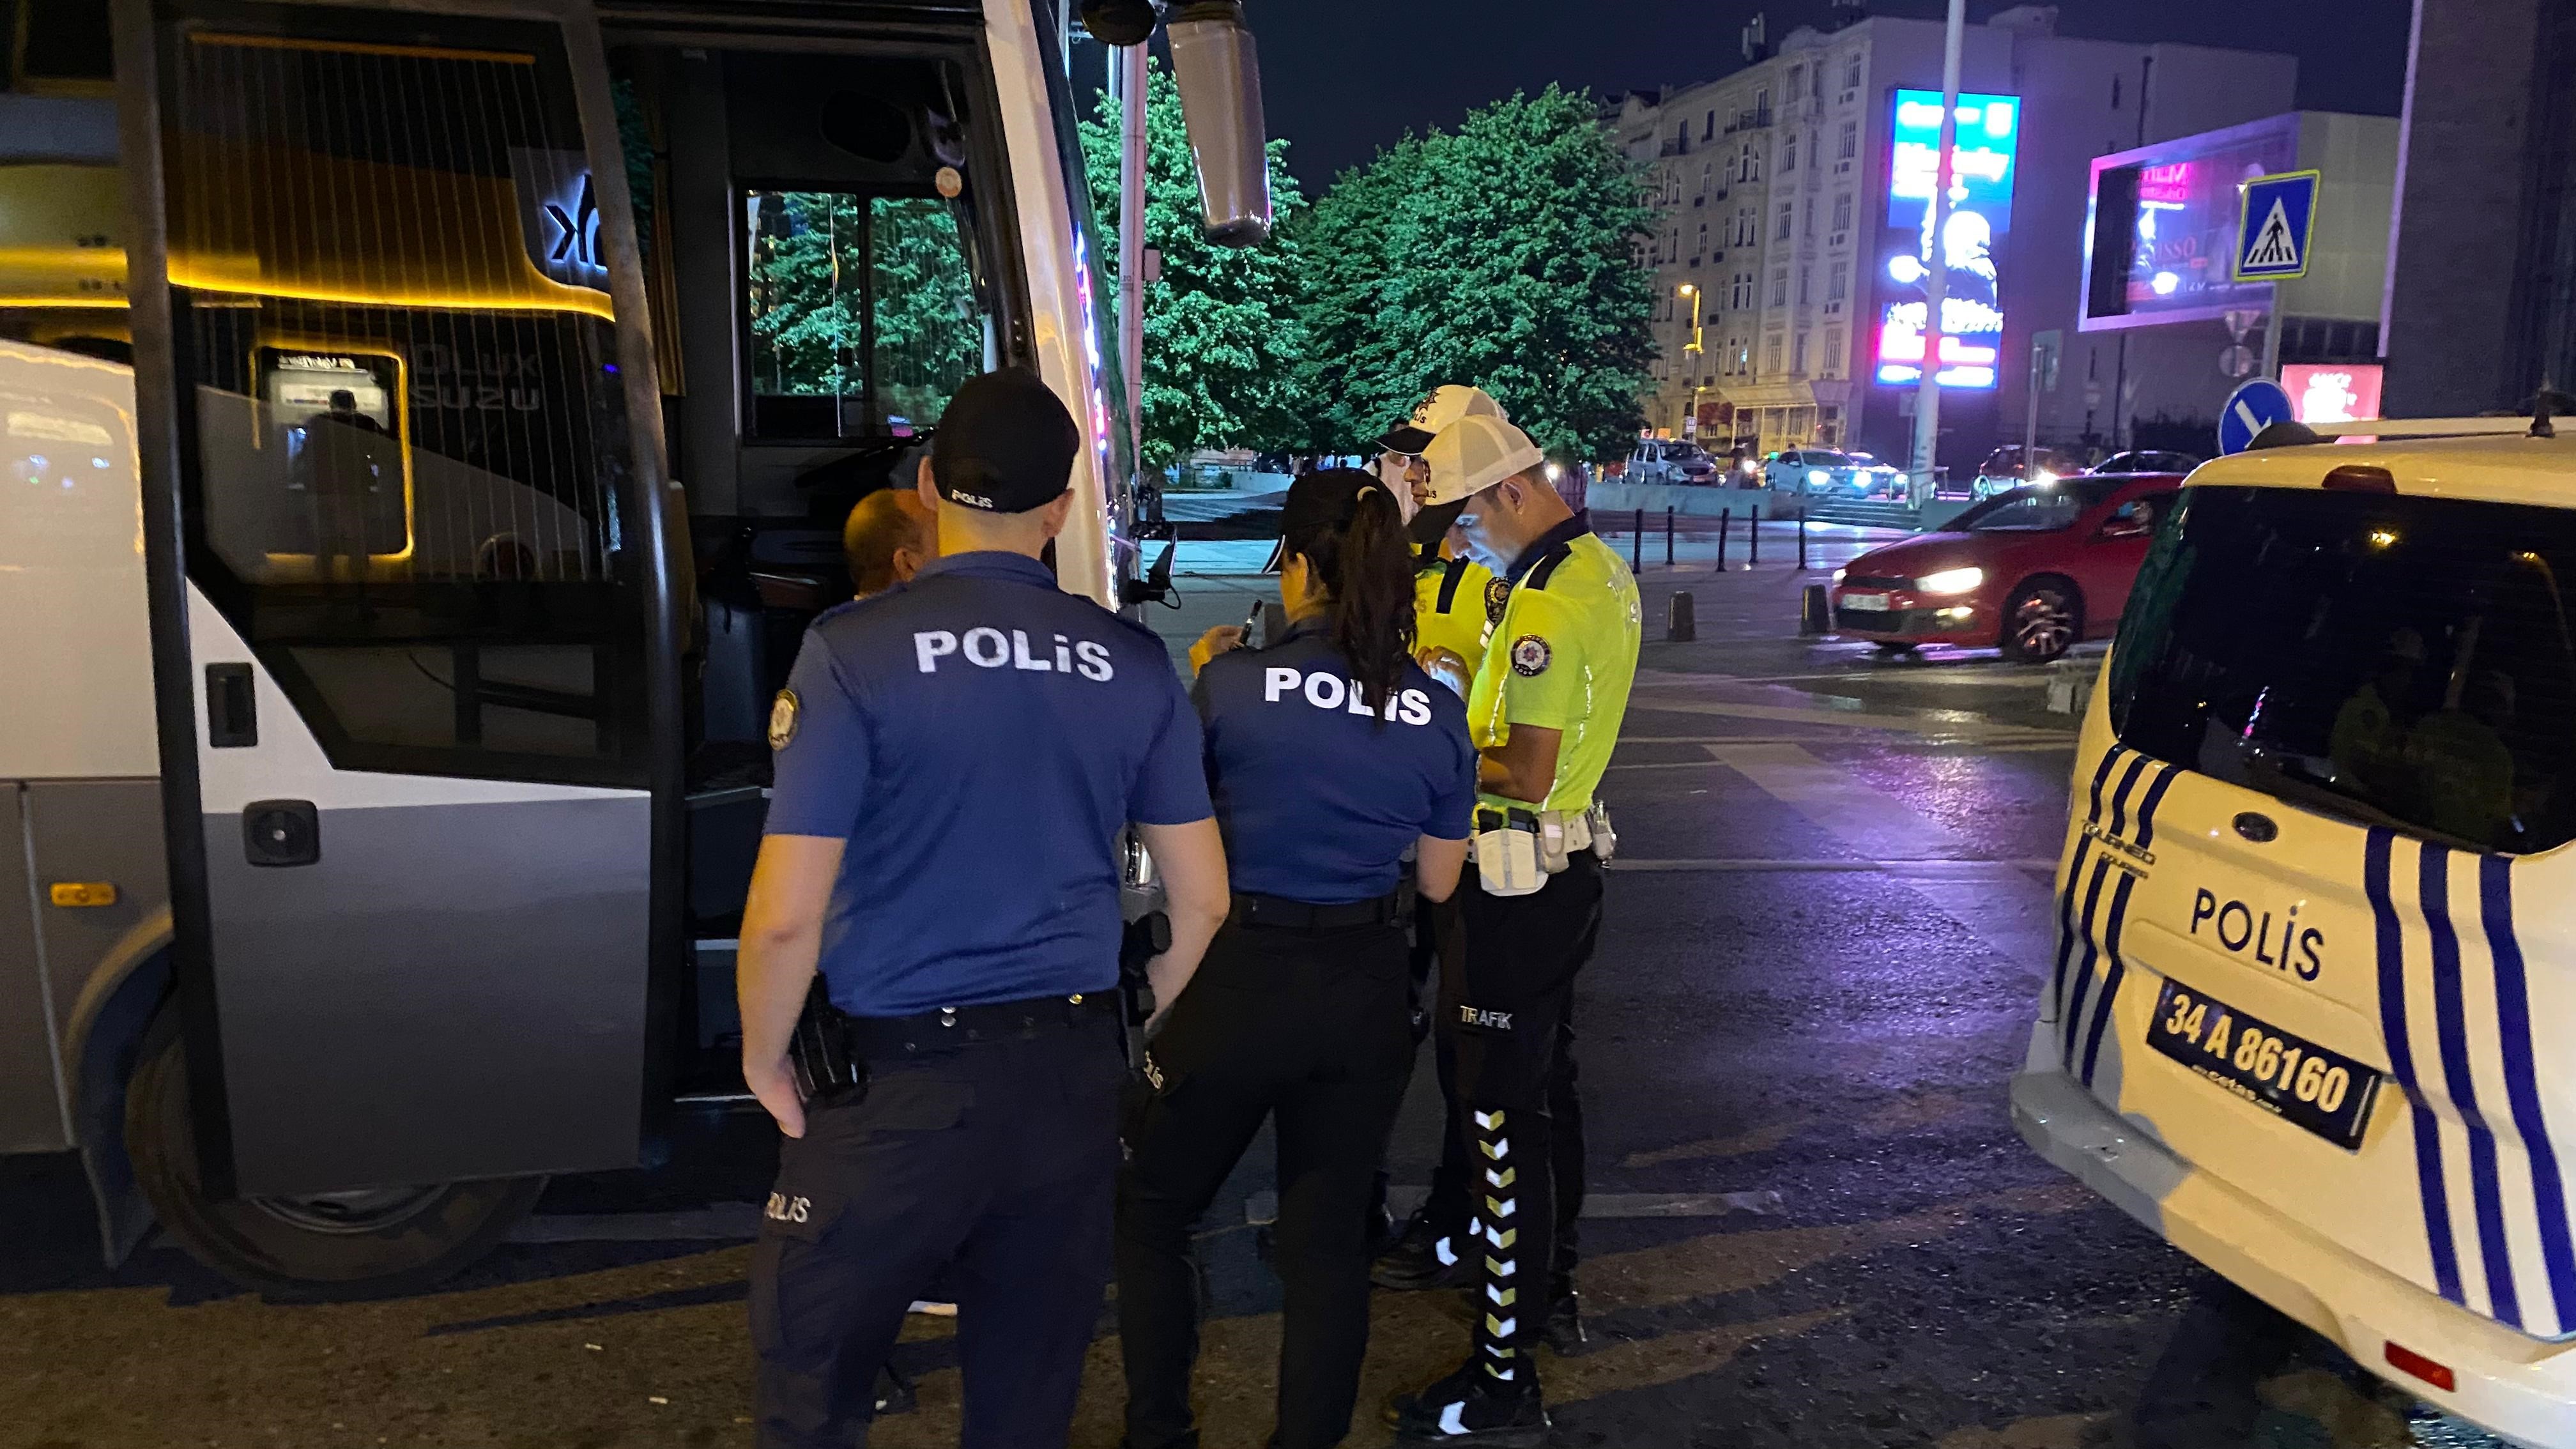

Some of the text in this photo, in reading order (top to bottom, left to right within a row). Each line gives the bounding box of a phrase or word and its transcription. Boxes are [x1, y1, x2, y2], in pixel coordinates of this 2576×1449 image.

[2191, 887, 2324, 983] POLİS
[2166, 993, 2205, 1045] 34
[2205, 1014, 2232, 1060] A
[2234, 1027, 2350, 1114] 86160
